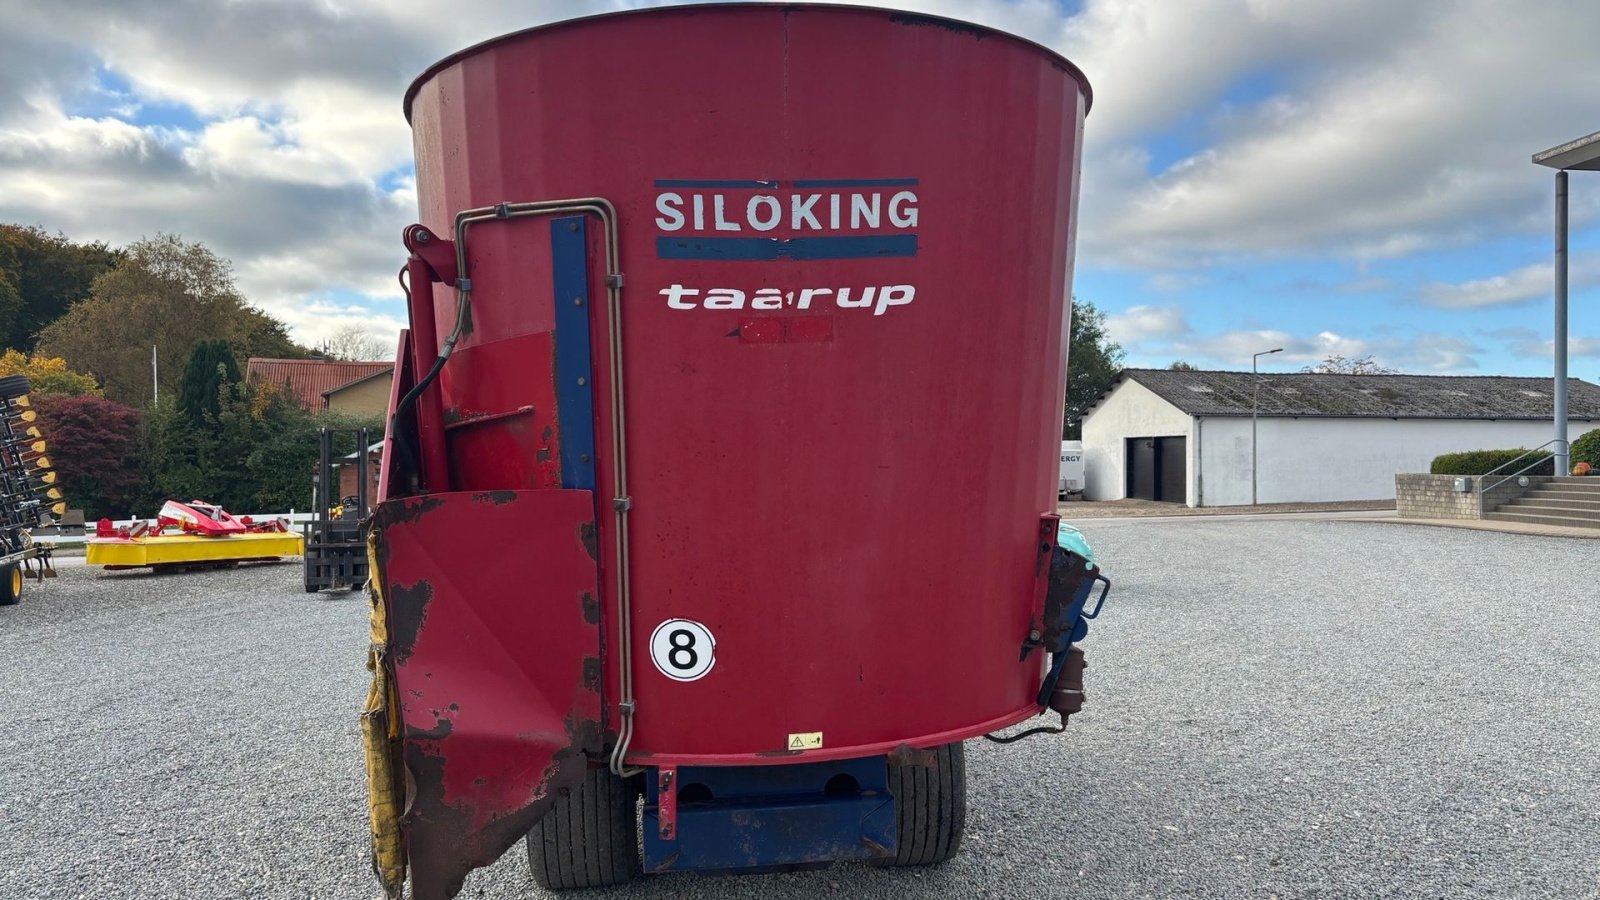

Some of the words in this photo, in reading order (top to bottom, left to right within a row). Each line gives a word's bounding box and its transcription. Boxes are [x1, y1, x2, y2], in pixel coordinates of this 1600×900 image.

[655, 191, 919, 232] SILOKING
[658, 284, 916, 316] taarup
[668, 629, 698, 670] 8
